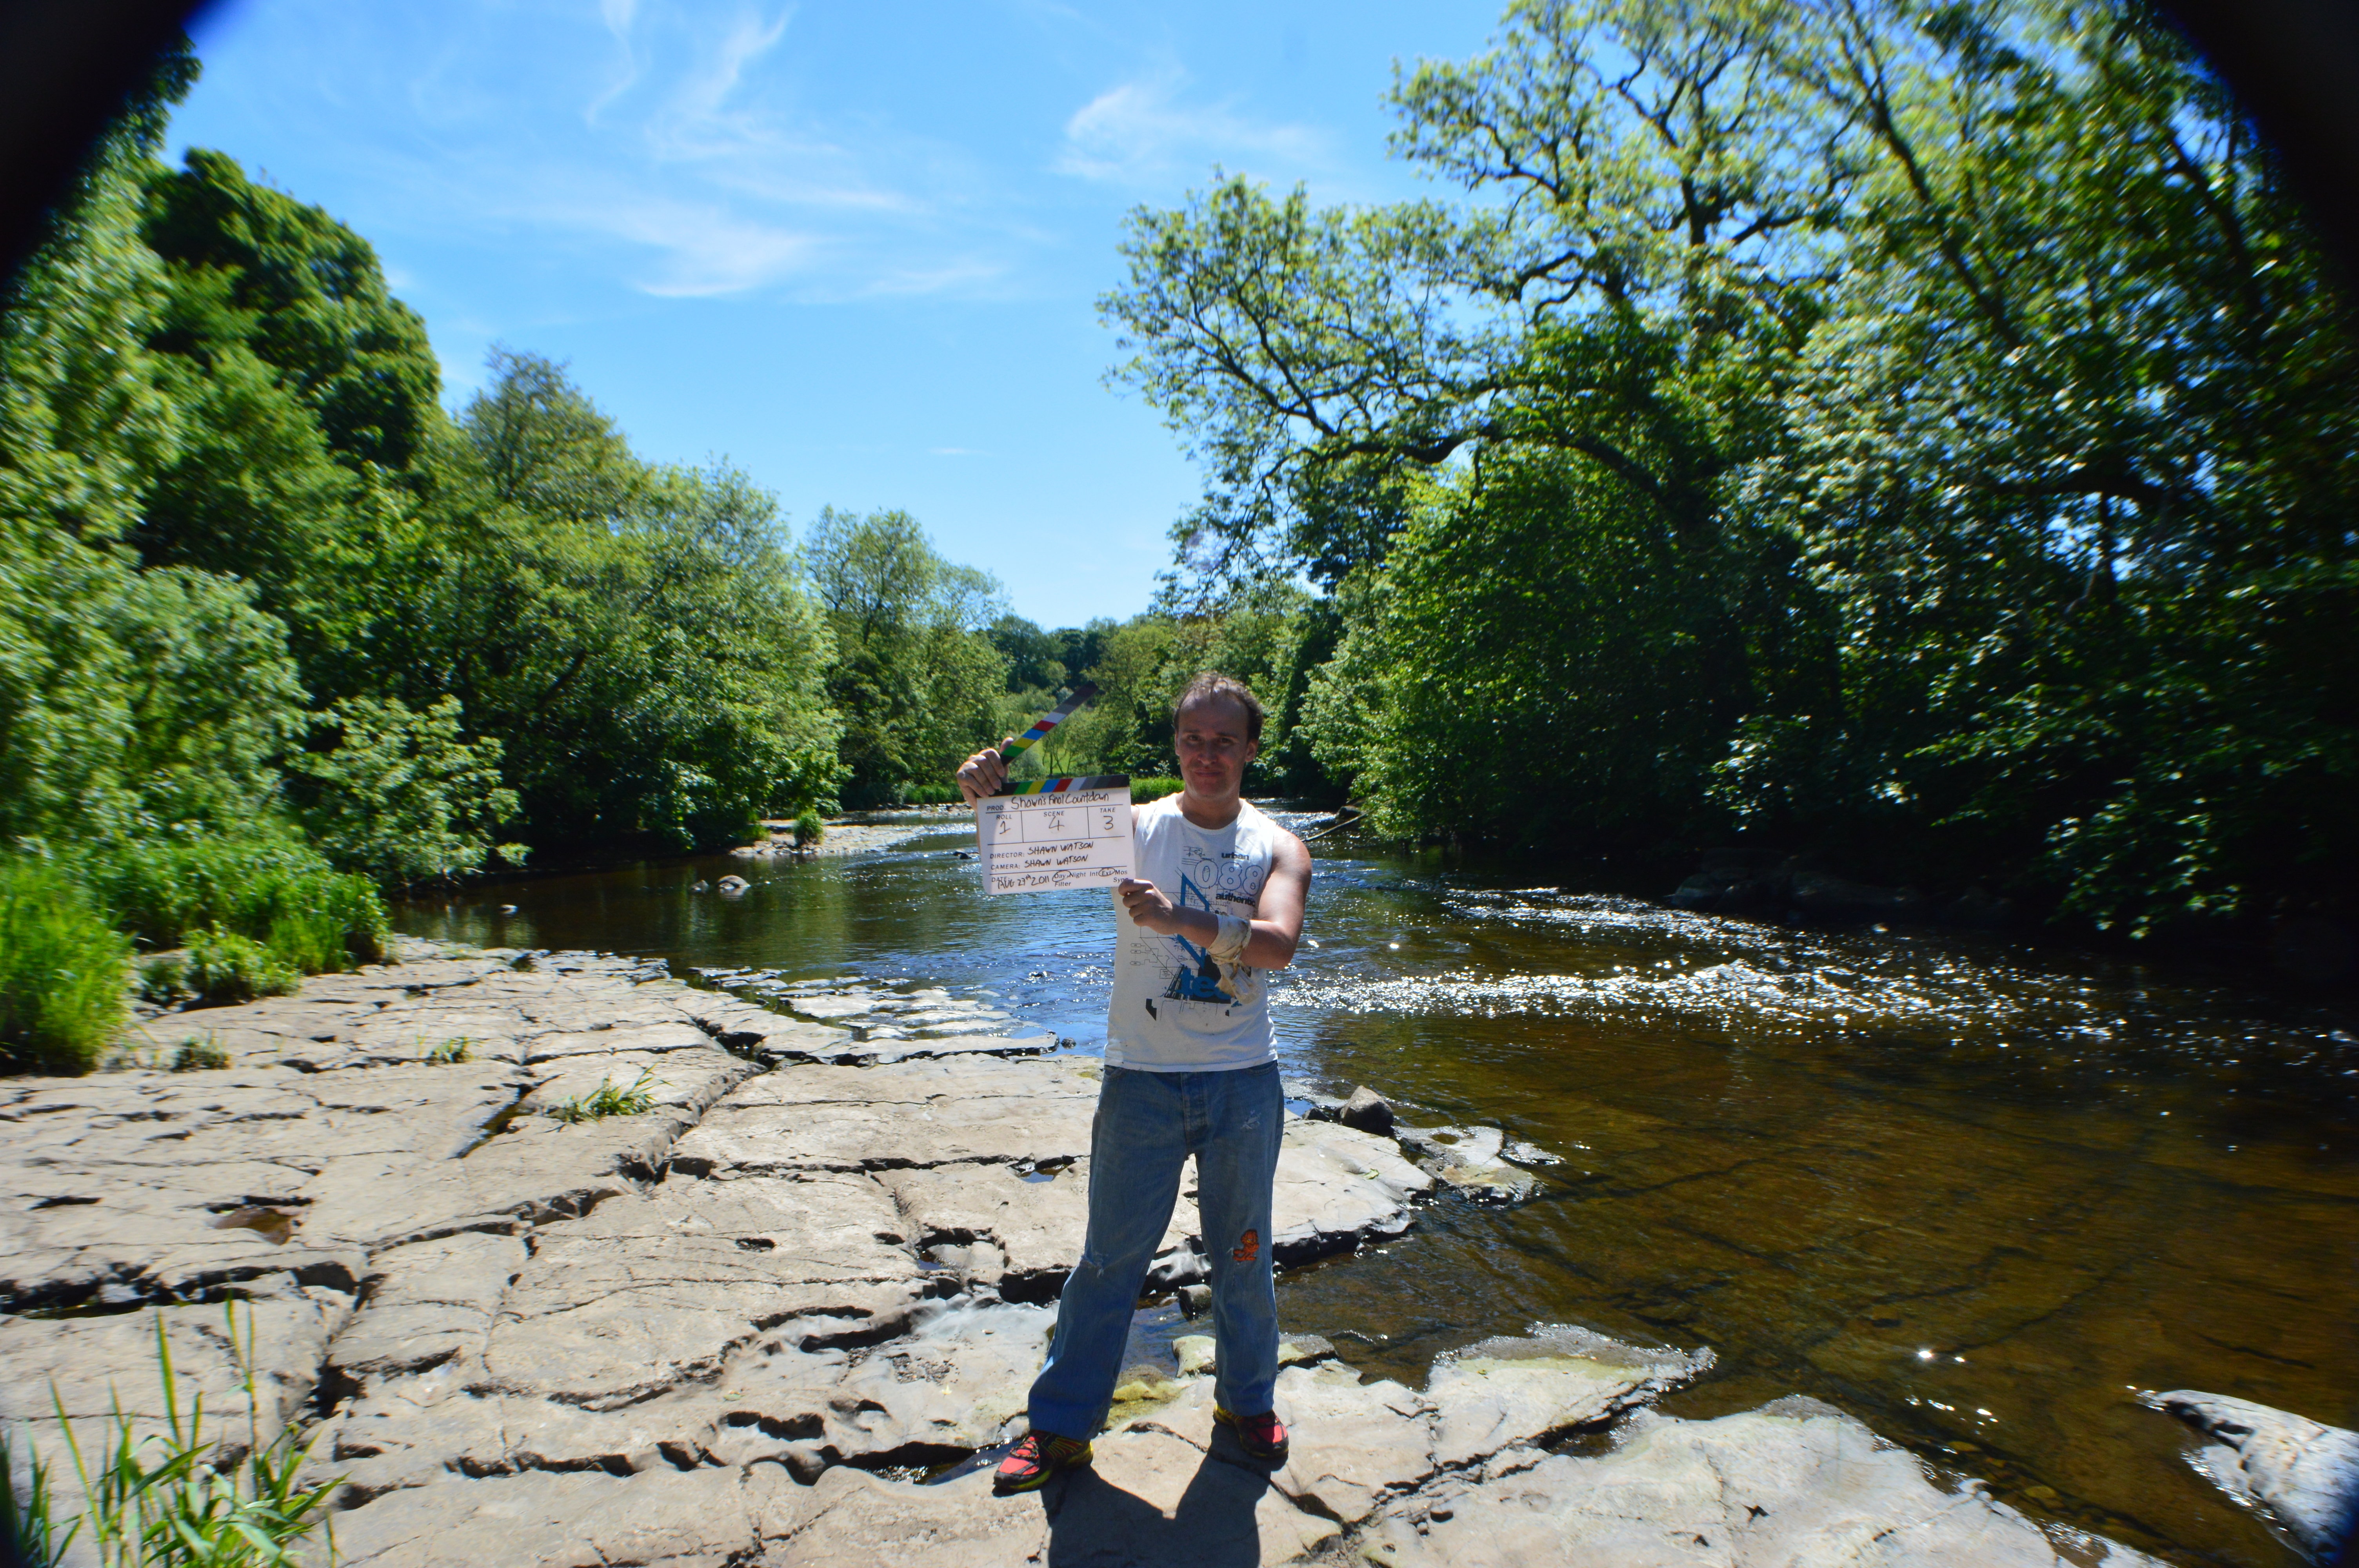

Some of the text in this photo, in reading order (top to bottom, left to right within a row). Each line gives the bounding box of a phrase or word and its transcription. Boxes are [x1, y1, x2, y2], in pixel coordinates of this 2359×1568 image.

[1049, 796, 1064, 805] Final
[999, 821, 1010, 834] 1
[1049, 816, 1065, 831] 4
[1103, 816, 1114, 829] 3
[1027, 841, 1094, 855] SHAWN WATSON
[1024, 855, 1089, 868] SHAWN WATSON
[1221, 852, 1249, 860] urban
[1031, 876, 1049, 886] 2011
[1194, 860, 1264, 896] 088
[1216, 893, 1256, 907] authentic
